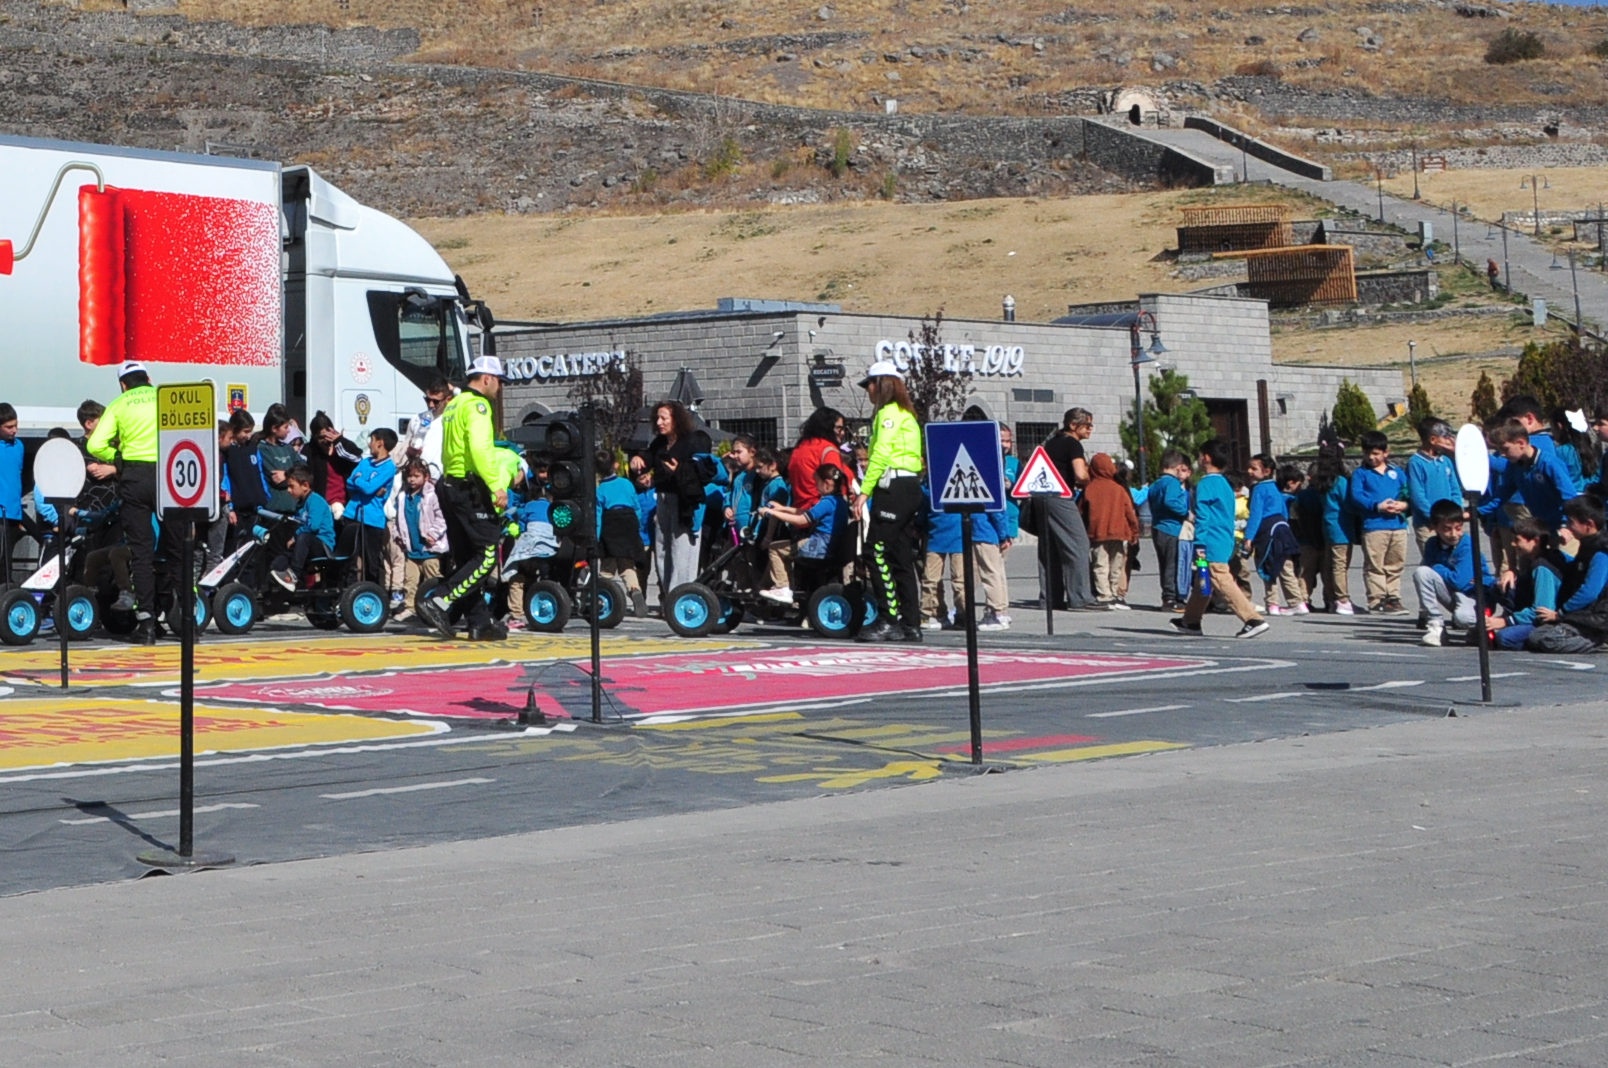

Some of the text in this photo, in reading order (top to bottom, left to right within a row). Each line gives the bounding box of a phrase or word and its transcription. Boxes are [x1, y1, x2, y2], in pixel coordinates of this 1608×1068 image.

[979, 344, 1025, 375] 1919
[170, 390, 202, 405] OKUL
[161, 408, 211, 427] BÖLGESİ
[175, 459, 198, 488] 30
